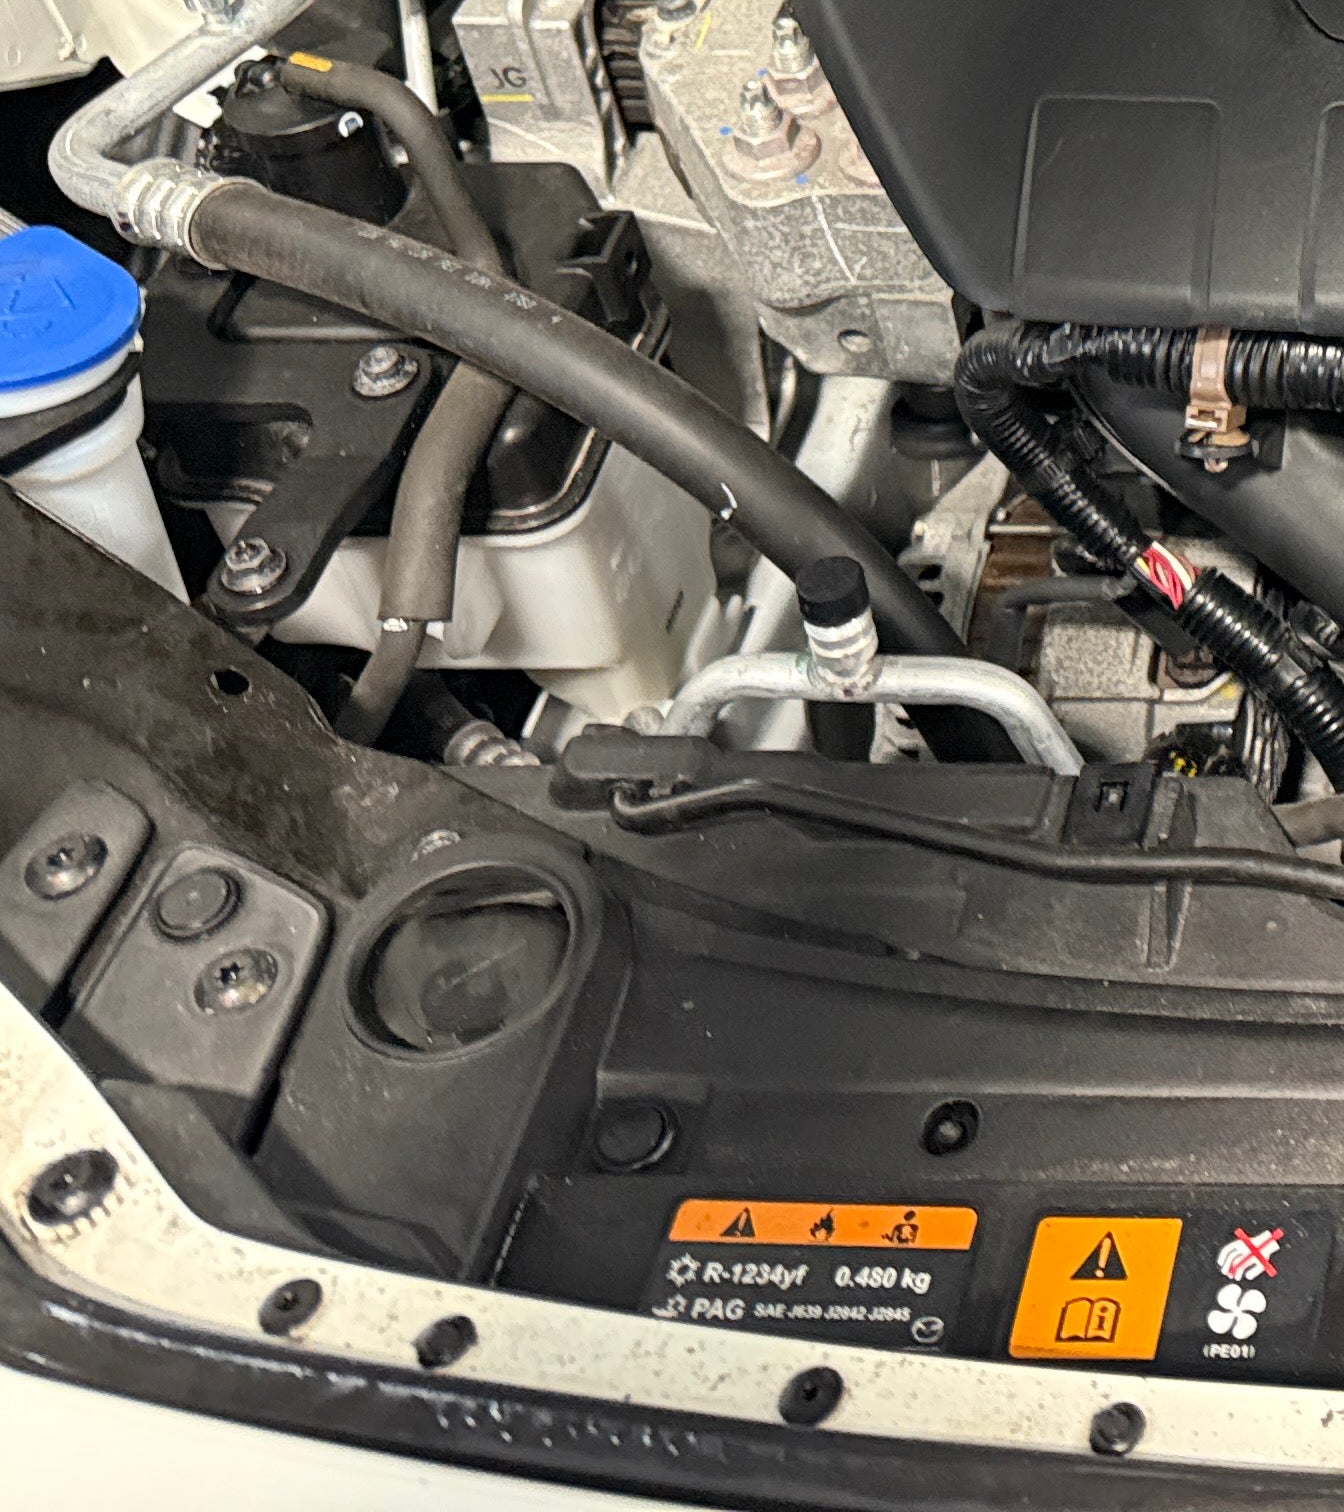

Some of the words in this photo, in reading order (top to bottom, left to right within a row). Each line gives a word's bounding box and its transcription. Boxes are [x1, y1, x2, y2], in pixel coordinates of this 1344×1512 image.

[489, 66, 527, 89] JG
[703, 1261, 809, 1290] R-1234yf
[835, 1266, 898, 1289] 0.480
[901, 1268, 932, 1295] kg
[690, 1298, 746, 1321] PAG
[754, 1302, 787, 1319] SAE
[1202, 1343, 1256, 1359] (PE01)
